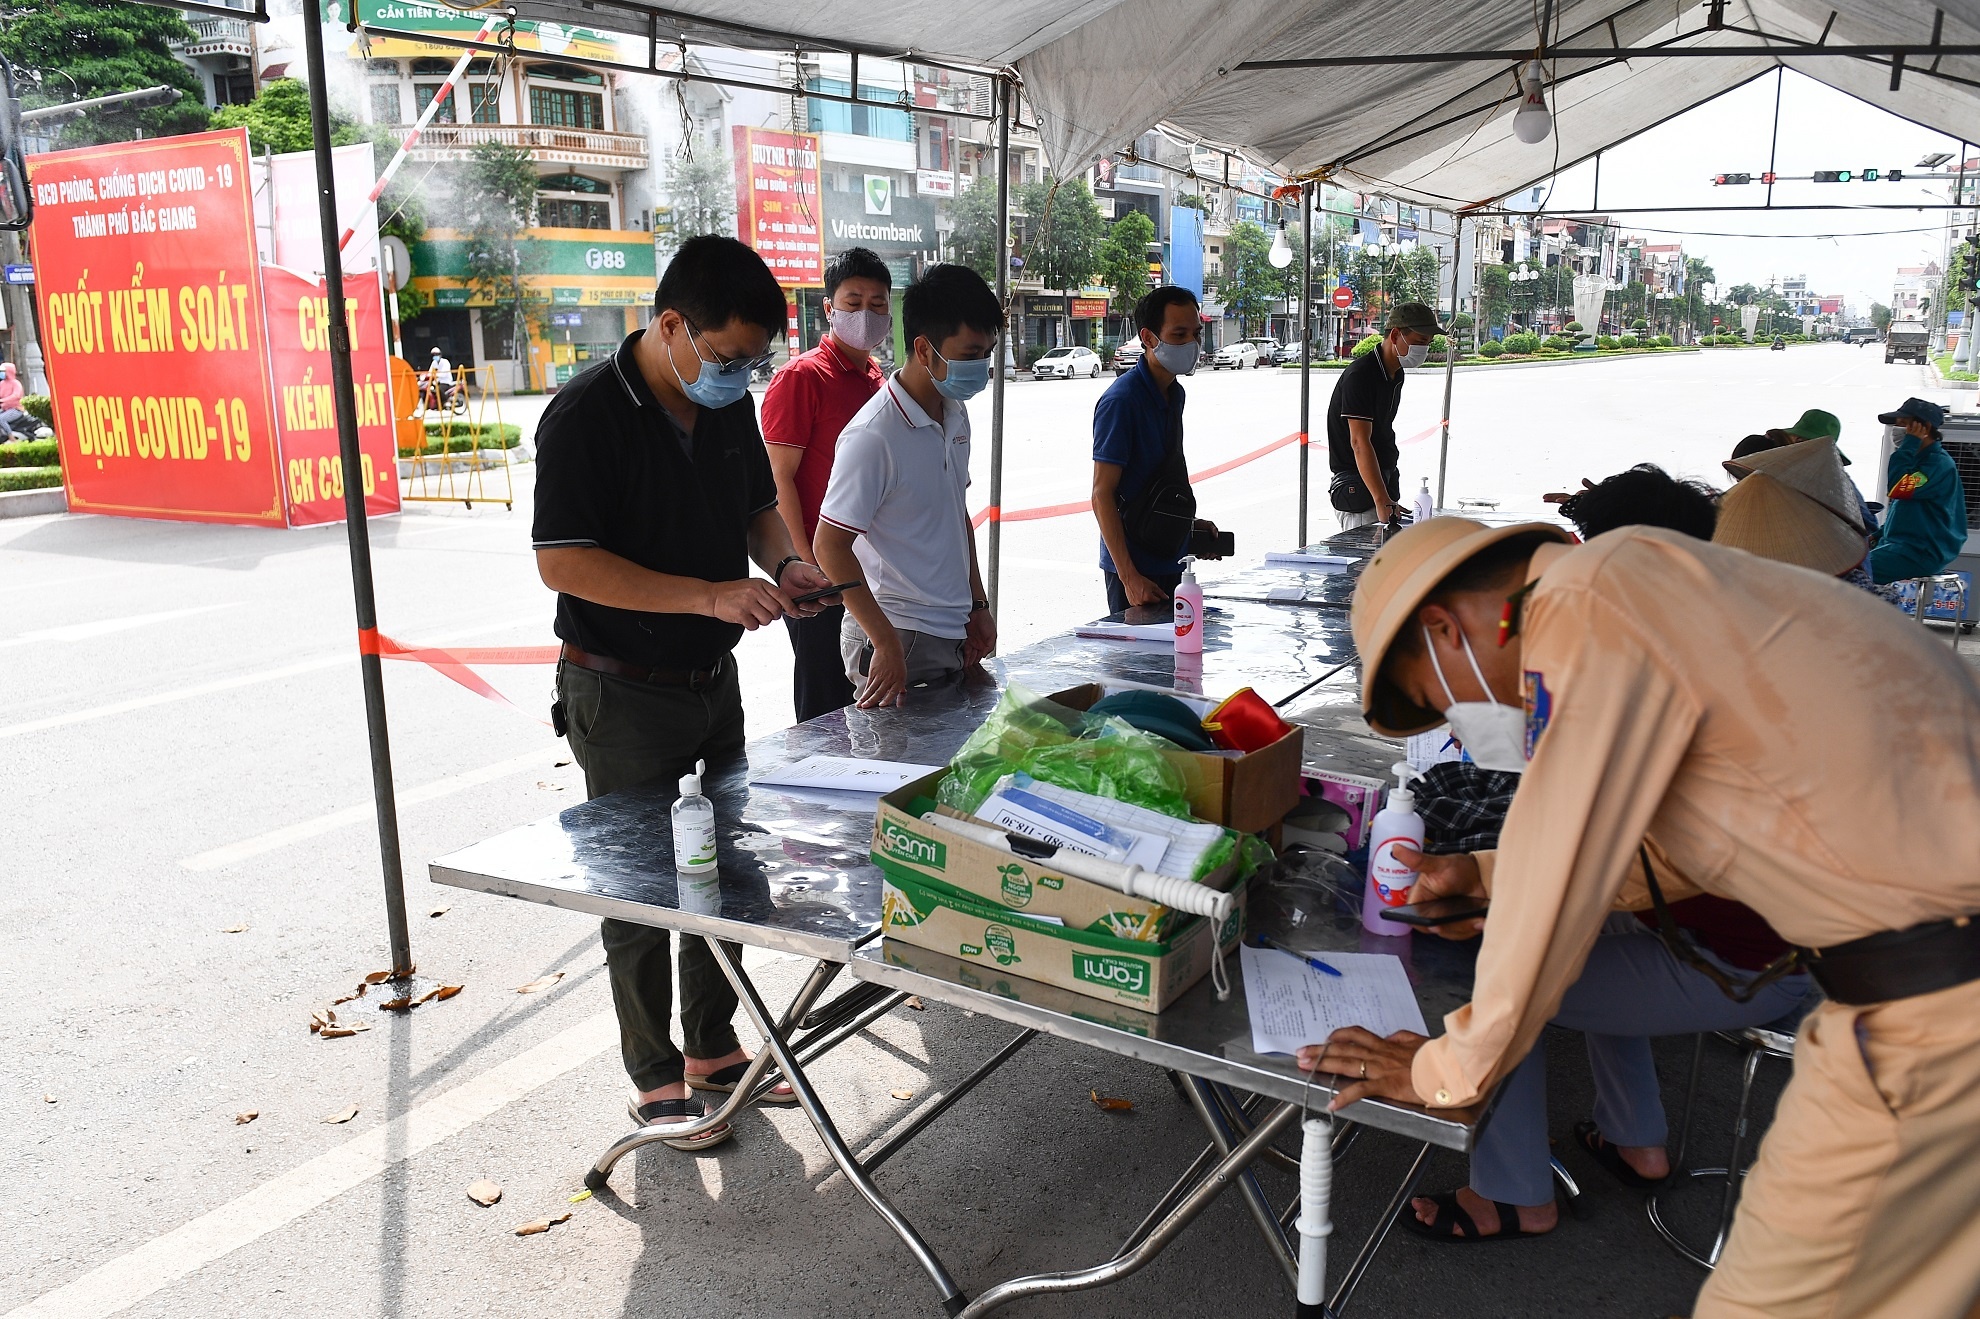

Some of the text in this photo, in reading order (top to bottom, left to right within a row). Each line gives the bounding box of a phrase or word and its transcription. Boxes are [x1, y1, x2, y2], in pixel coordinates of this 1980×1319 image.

[376, 4, 404, 19] CẦN
[37, 183, 57, 206] BCĐ
[60, 175, 98, 203] PHÒNG,
[99, 168, 136, 200] CHỐNG
[138, 171, 167, 200] DỊCH
[168, 166, 205, 193] COVID
[216, 164, 232, 188] 19
[72, 202, 196, 239] THÀNH PHỐ BẮC GIANG
[763, 200, 782, 213] SIM
[831, 218, 922, 242] Vietcombank
[585, 248, 626, 270] F88
[49, 262, 249, 354] CHỐT KIỂM SOÁT
[298, 296, 358, 352] CHT
[283, 366, 334, 432] KIỂM
[72, 395, 251, 470] DỊCH COVID-19
[1002, 816, 1035, 835] 118.30
